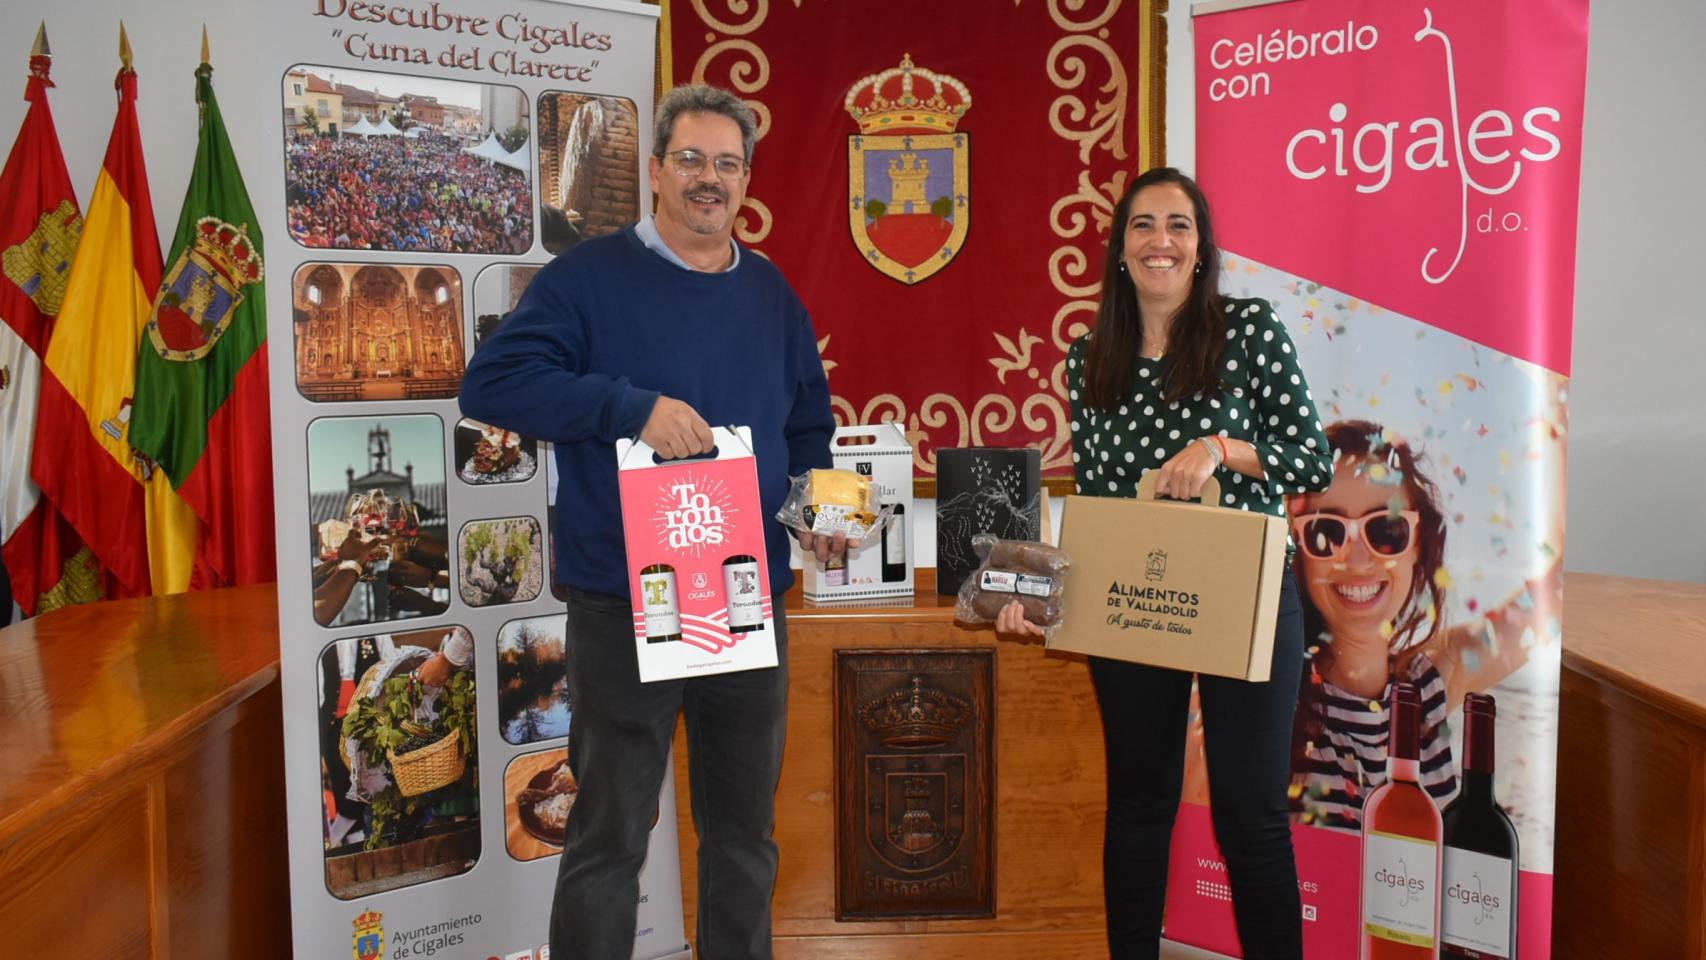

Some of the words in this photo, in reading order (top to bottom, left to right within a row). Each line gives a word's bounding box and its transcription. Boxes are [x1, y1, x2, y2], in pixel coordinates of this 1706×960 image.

[313, 0, 489, 36] Descubre
[496, 12, 612, 53] Cigales
[437, 44, 484, 70] del
[1210, 21, 1378, 69] Celébralo
[1209, 72, 1270, 101] con
[1476, 208, 1529, 233] d.o.
[669, 523, 724, 548] dos
[1109, 581, 1199, 605] ALIMENTOS
[1107, 597, 1121, 607] DE
[1127, 597, 1198, 618] VALLADOLID
[1106, 613, 1123, 625] A
[1121, 618, 1152, 630] gusto
[1152, 620, 1164, 631] de
[1167, 622, 1192, 635] todos
[1298, 880, 1318, 893] .es
[393, 914, 482, 945] Ayuntamiento
[393, 947, 409, 960] de
[412, 933, 464, 956] Cigales
